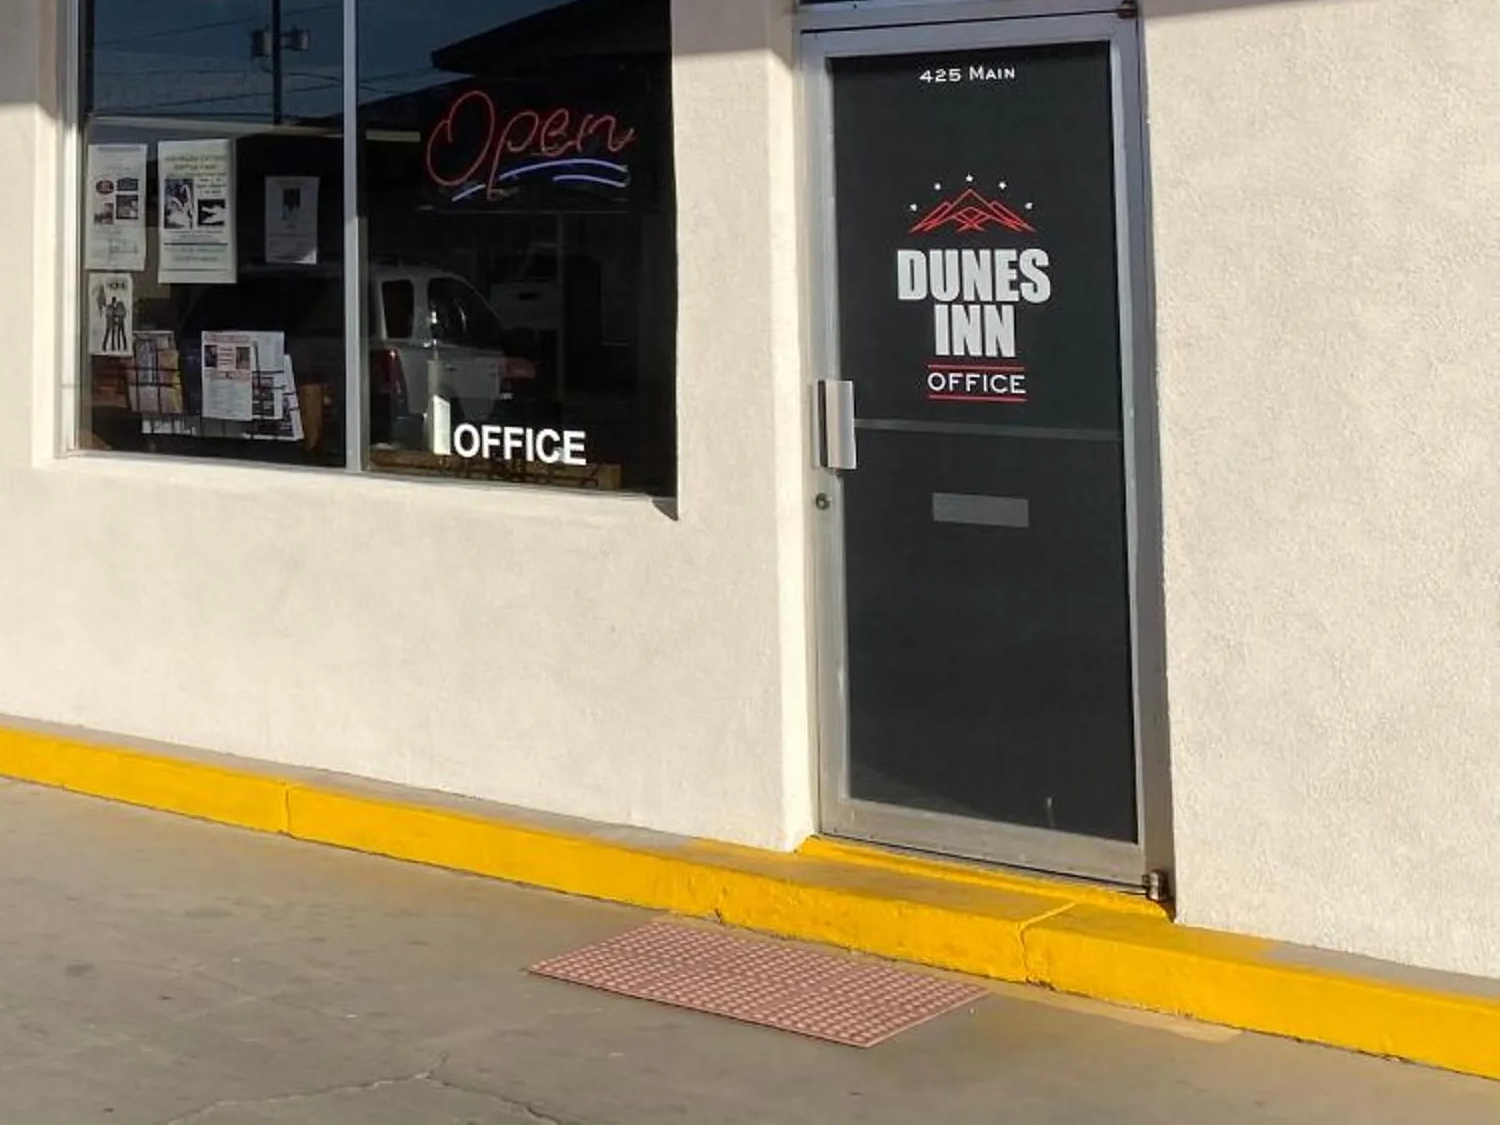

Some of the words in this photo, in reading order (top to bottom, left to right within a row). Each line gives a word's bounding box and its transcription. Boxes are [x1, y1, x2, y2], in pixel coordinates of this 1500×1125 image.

[919, 68, 962, 83] 425
[426, 90, 635, 201] Open
[897, 248, 1051, 303] DUNES
[934, 304, 1016, 357] INN
[928, 372, 1026, 394] OFFICE
[453, 422, 587, 466] OFFICE
